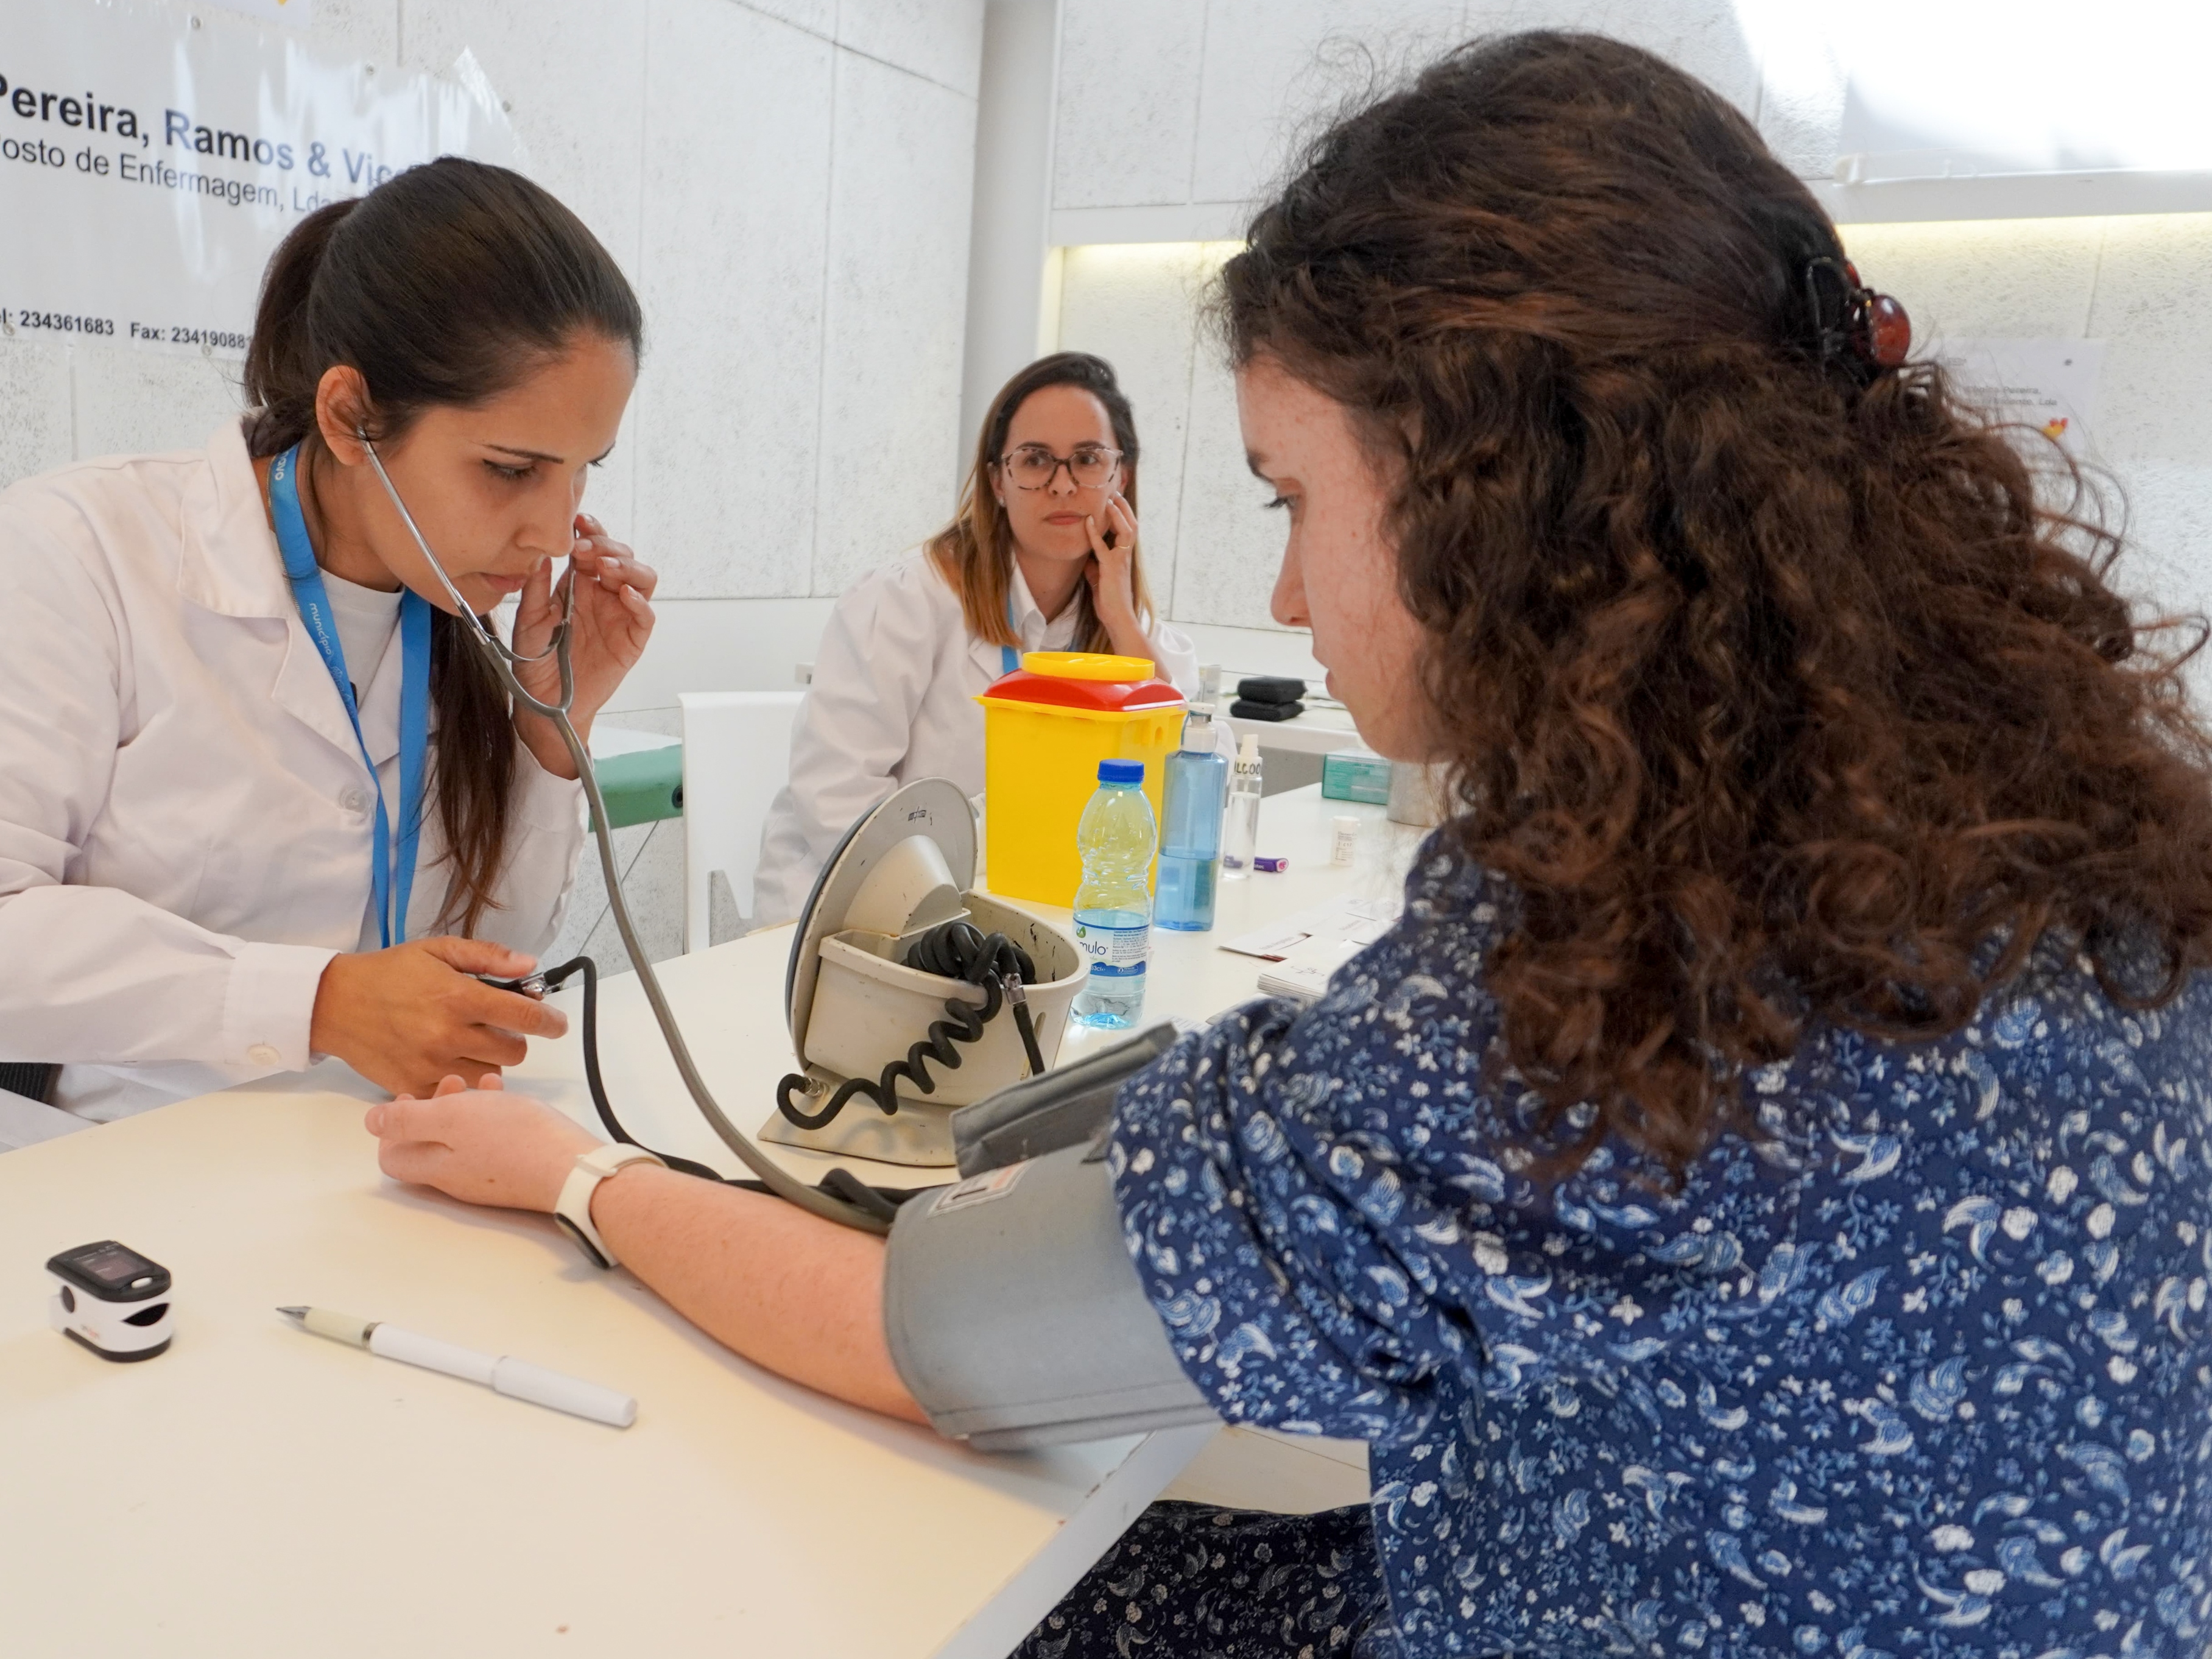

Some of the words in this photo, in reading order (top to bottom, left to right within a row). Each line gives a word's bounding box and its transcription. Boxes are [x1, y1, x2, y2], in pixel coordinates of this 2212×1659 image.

[1, 138, 65, 167] osto
[76, 146, 109, 175] de
[120, 153, 284, 212] Enfermagem,
[165, 108, 295, 171] Ramos
[308, 141, 331, 178] &
[342, 148, 403, 186] Vic
[20, 309, 114, 335] 234361683
[130, 322, 166, 340] Fax:
